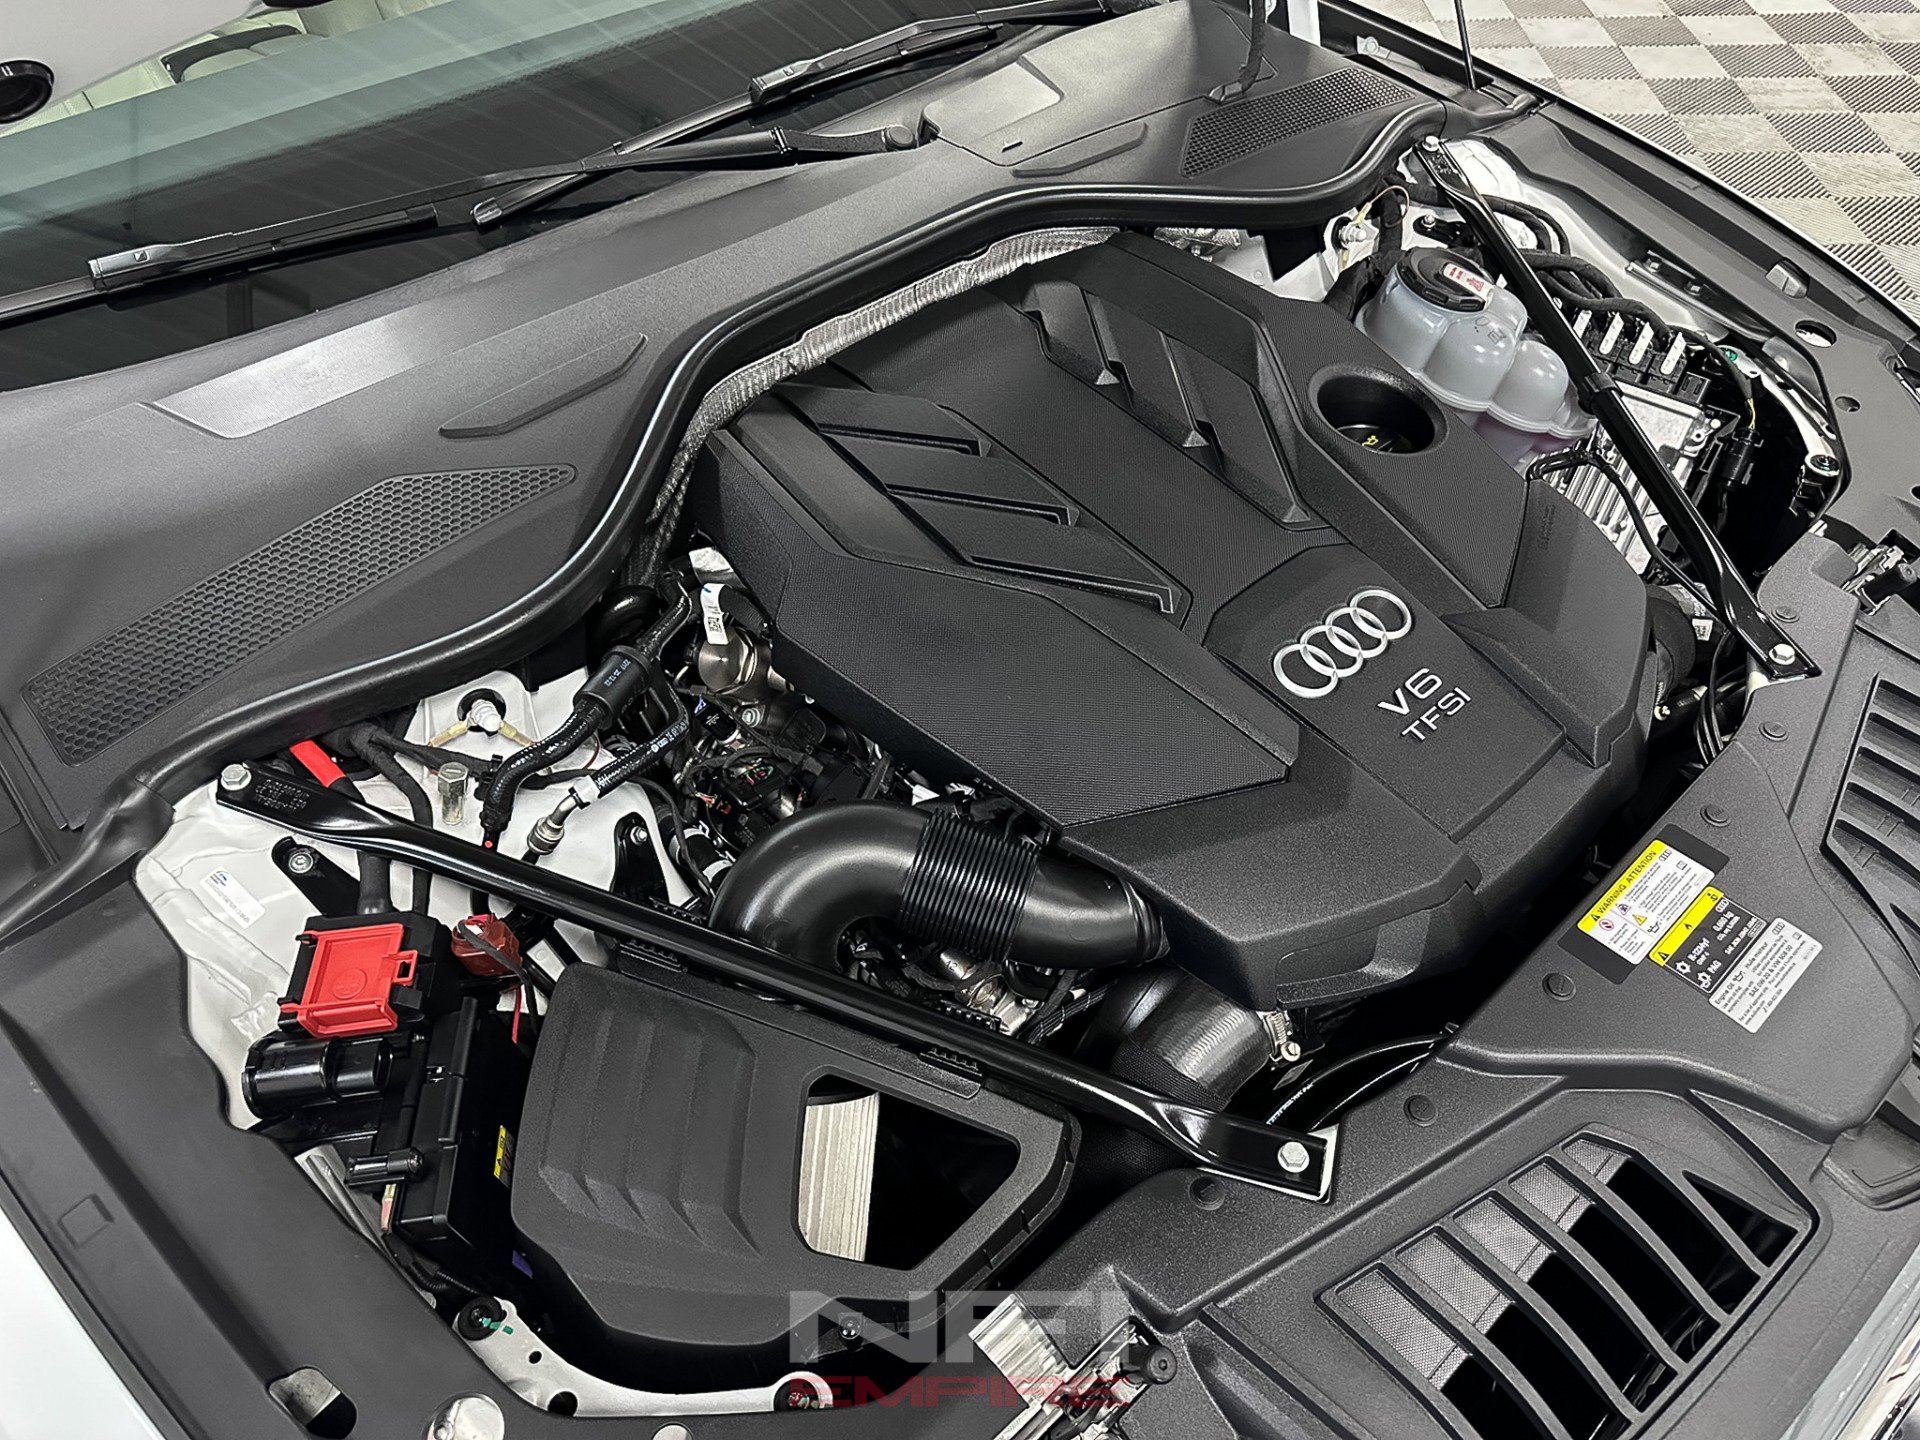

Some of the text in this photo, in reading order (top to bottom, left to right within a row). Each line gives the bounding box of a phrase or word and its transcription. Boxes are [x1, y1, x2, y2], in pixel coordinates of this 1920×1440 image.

[1377, 668, 1442, 715] V6
[1402, 687, 1471, 741] TFSI
[1597, 884, 1626, 913] WARNING
[1626, 851, 1656, 883] ATTENTION
[1707, 960, 1722, 973] PAG
[1714, 990, 1729, 1004] Engine
[1745, 957, 1756, 969] Huile
[1754, 942, 1768, 958] moteur
[1748, 986, 1759, 997] SAE
[1771, 959, 1781, 968] VW
